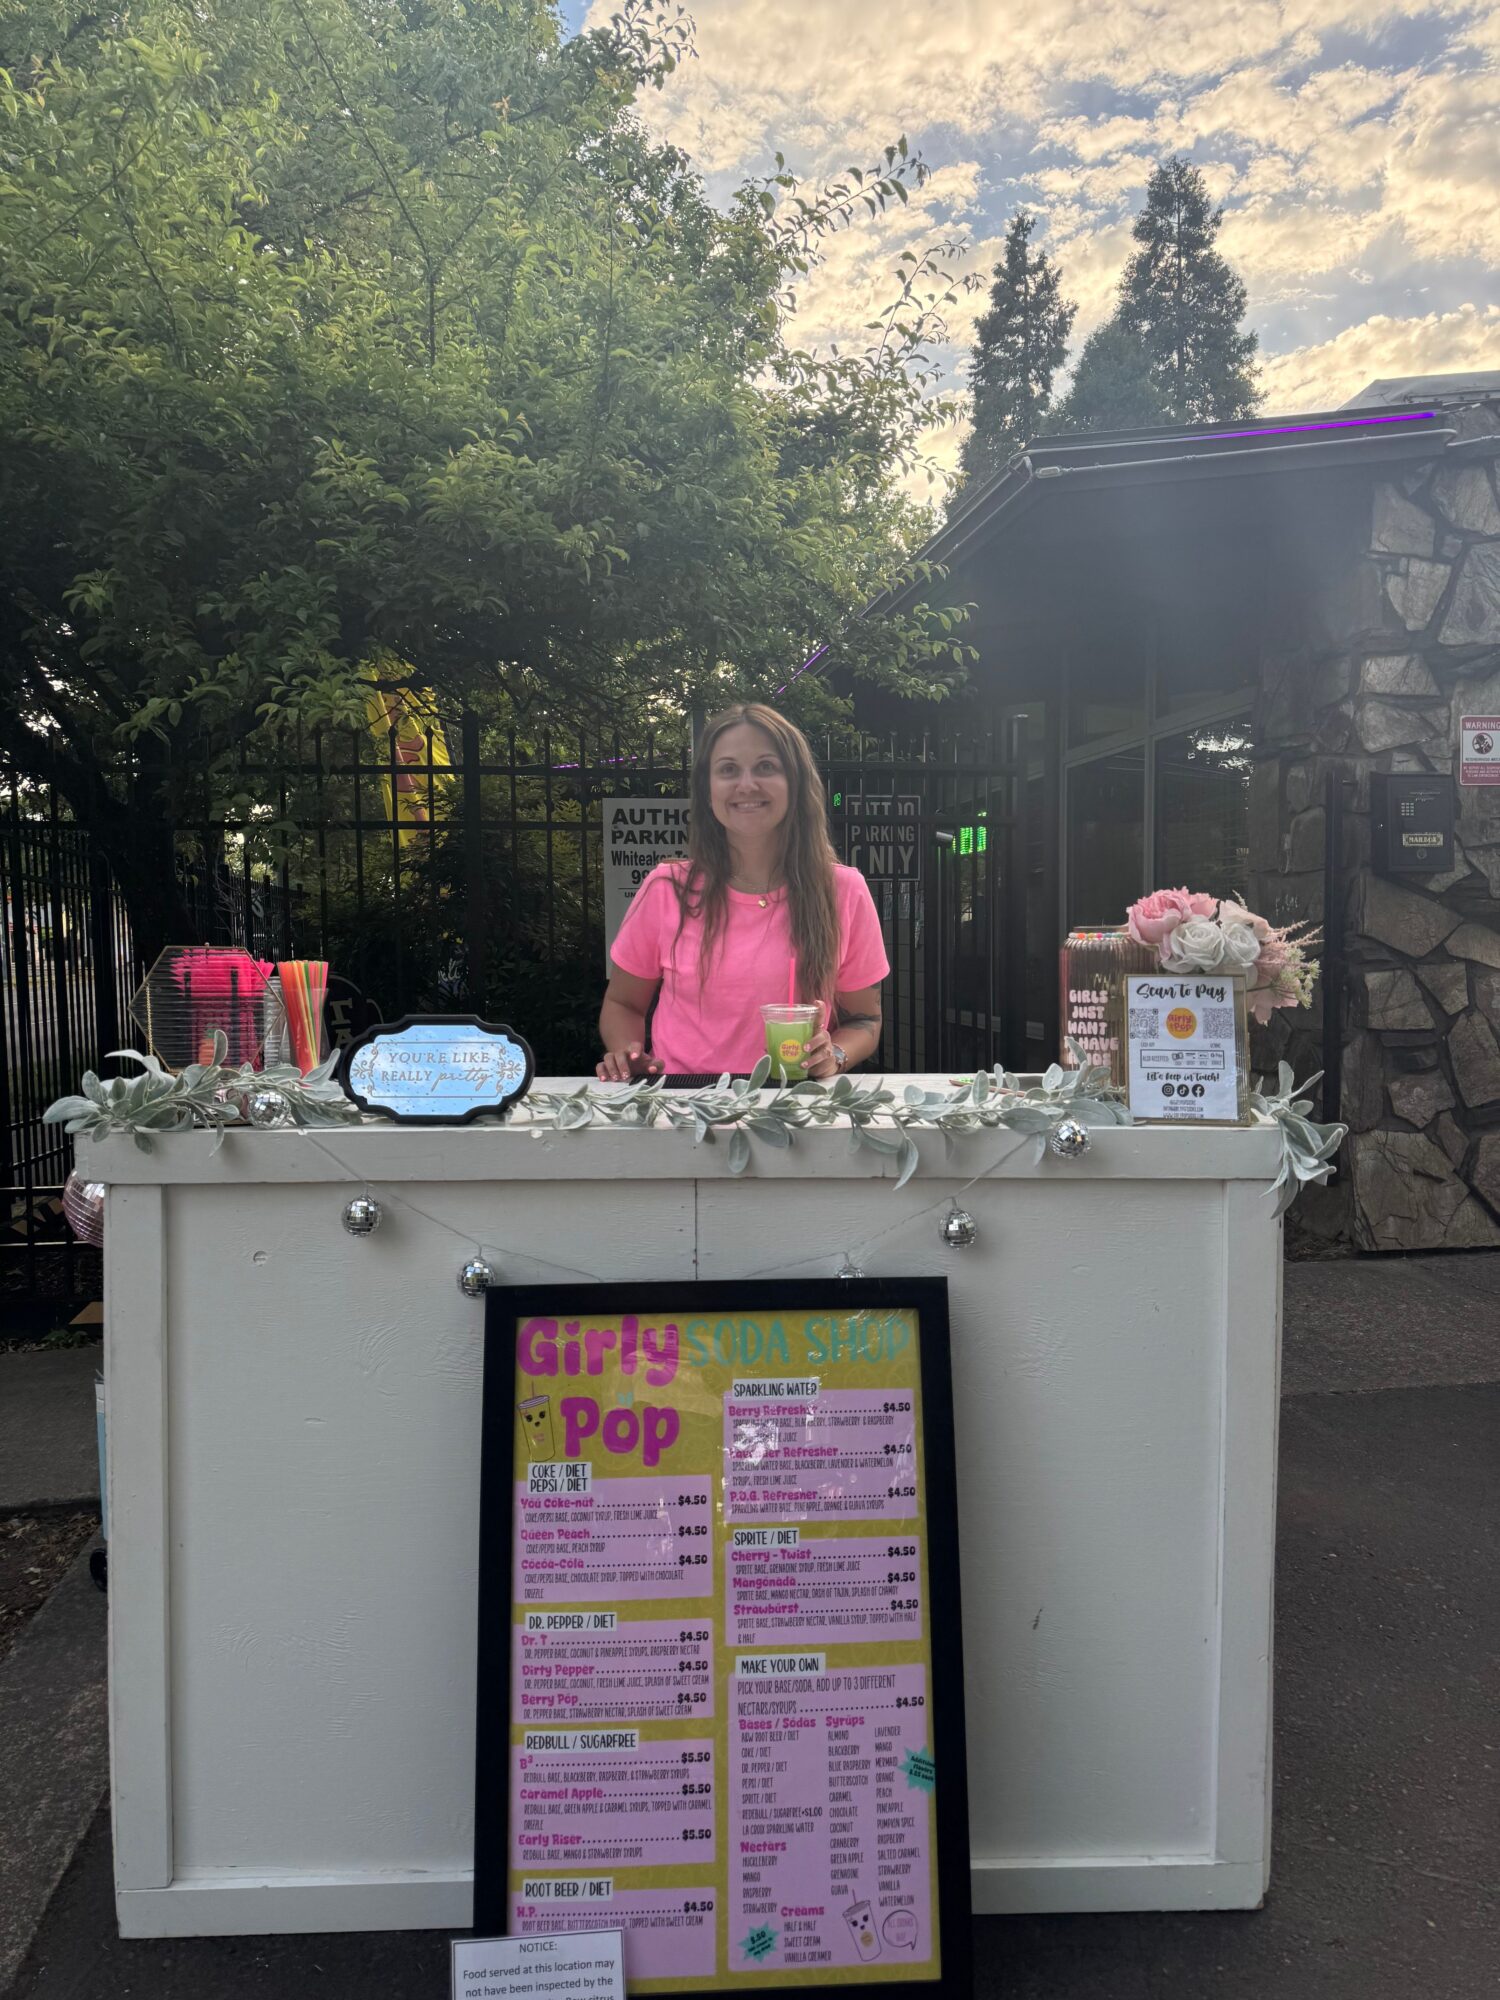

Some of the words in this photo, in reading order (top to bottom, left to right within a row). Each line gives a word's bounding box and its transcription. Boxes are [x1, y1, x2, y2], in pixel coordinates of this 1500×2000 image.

[1465, 721, 1500, 729] WARNING
[851, 802, 915, 815] TTTO
[611, 830, 689, 844] PARKIN
[1069, 989, 1109, 1003] GIRLS
[1136, 983, 1177, 999] Scan
[1178, 984, 1191, 998] to
[1195, 984, 1227, 1002] Pay
[1072, 1006, 1105, 1019] JUST
[1068, 1021, 1108, 1034] WANT
[1079, 1037, 1120, 1050] HAVE
[389, 1052, 446, 1063] YOU'RE
[452, 1052, 490, 1063] LIKE
[381, 1070, 433, 1081] REALLY
[431, 1067, 494, 1092] pretty
[518, 1315, 680, 1387] Girly
[685, 1317, 790, 1368] SODA
[803, 1316, 910, 1365] SHOP
[734, 1382, 784, 1398] SPARKLING
[786, 1382, 817, 1395] WATER
[728, 1405, 760, 1418] Berry
[763, 1405, 818, 1416] Refresh
[883, 1402, 911, 1413] $4.50
[560, 1396, 681, 1467] Pop
[783, 1446, 838, 1458] Refresher
[884, 1444, 912, 1455] $4.50
[532, 1464, 556, 1479] COKE
[566, 1463, 587, 1478] DIET
[530, 1479, 557, 1493] PEPSI
[567, 1478, 588, 1492] DIET
[520, 1497, 542, 1509] You
[543, 1497, 595, 1508] Coke-nut
[678, 1495, 707, 1506] $4.50
[729, 1491, 760, 1502] P.O.G.
[763, 1490, 818, 1500] Refresher
[887, 1487, 916, 1498] $4.50
[520, 1530, 555, 1541] Queen
[557, 1528, 590, 1540] Peach
[678, 1526, 708, 1537] $4.50
[734, 1531, 768, 1546] SPRITE
[777, 1530, 798, 1544] DIET
[521, 1558, 585, 1570] Cocoa-Cola
[678, 1554, 708, 1566] $4.50
[731, 1550, 770, 1563] Cherry
[780, 1548, 812, 1560] Twist
[887, 1546, 916, 1558] $4.50
[732, 1576, 796, 1590] Mangonada
[887, 1572, 916, 1583] $4.50
[733, 1603, 799, 1615] Strawburst
[891, 1599, 919, 1611] $4.50
[528, 1615, 545, 1630] DR.
[547, 1615, 583, 1629] PEPPER
[593, 1614, 615, 1628] DIET
[521, 1635, 538, 1646] Dr.
[539, 1634, 548, 1645] T
[679, 1631, 709, 1642] $4.50
[522, 1665, 552, 1677] Dirty
[554, 1664, 595, 1677] Pepper
[678, 1660, 708, 1672] $4.50
[741, 1660, 767, 1674] MAKE
[770, 1658, 796, 1673] YOUR
[799, 1657, 819, 1671] OWN
[737, 1681, 753, 1695] PICK
[755, 1680, 773, 1694] YOUR
[816, 1678, 830, 1693] ADD
[832, 1677, 842, 1692] UP
[843, 1677, 852, 1691] TO
[854, 1676, 859, 1690] 3
[859, 1674, 896, 1690] DIFFERENT
[521, 1694, 555, 1707] Berry
[557, 1693, 578, 1706] Pop
[677, 1692, 707, 1704] $4.50
[738, 1700, 797, 1717] NECTARS/SYRUPS
[896, 1696, 925, 1709] $4.50
[738, 1718, 773, 1730] Bases
[782, 1717, 816, 1729] Sodas
[825, 1715, 865, 1728] Syrups
[526, 1735, 570, 1750] REDBULL
[580, 1733, 636, 1749] SUGARFREE
[681, 1752, 711, 1764] $5.50
[519, 1788, 568, 1800] Caramel
[571, 1787, 604, 1800] Apple
[681, 1784, 711, 1795] $5.50
[518, 1835, 549, 1847] Early
[552, 1834, 583, 1845] Riser
[682, 1829, 711, 1841] $5.50
[740, 1841, 787, 1853] Nectars
[525, 1882, 552, 1898] ROOT
[554, 1882, 579, 1897] BEER
[589, 1881, 612, 1897] DIET
[683, 1901, 714, 1912] $4.50
[780, 1906, 825, 1918] Creams
[519, 1941, 558, 1953] NOTICE:
[463, 1969, 487, 1980] Food
[489, 1966, 521, 1977] served
[523, 1966, 532, 1975] at
[534, 1963, 552, 1974] this
[554, 1959, 592, 1971] location
[595, 1959, 615, 1971] may
[465, 1987, 482, 1998] not
[484, 1986, 507, 1996] have
[509, 1983, 533, 1994] been
[535, 1978, 581, 1992] inspected
[584, 1977, 595, 1988] by
[597, 1975, 613, 1986] the
